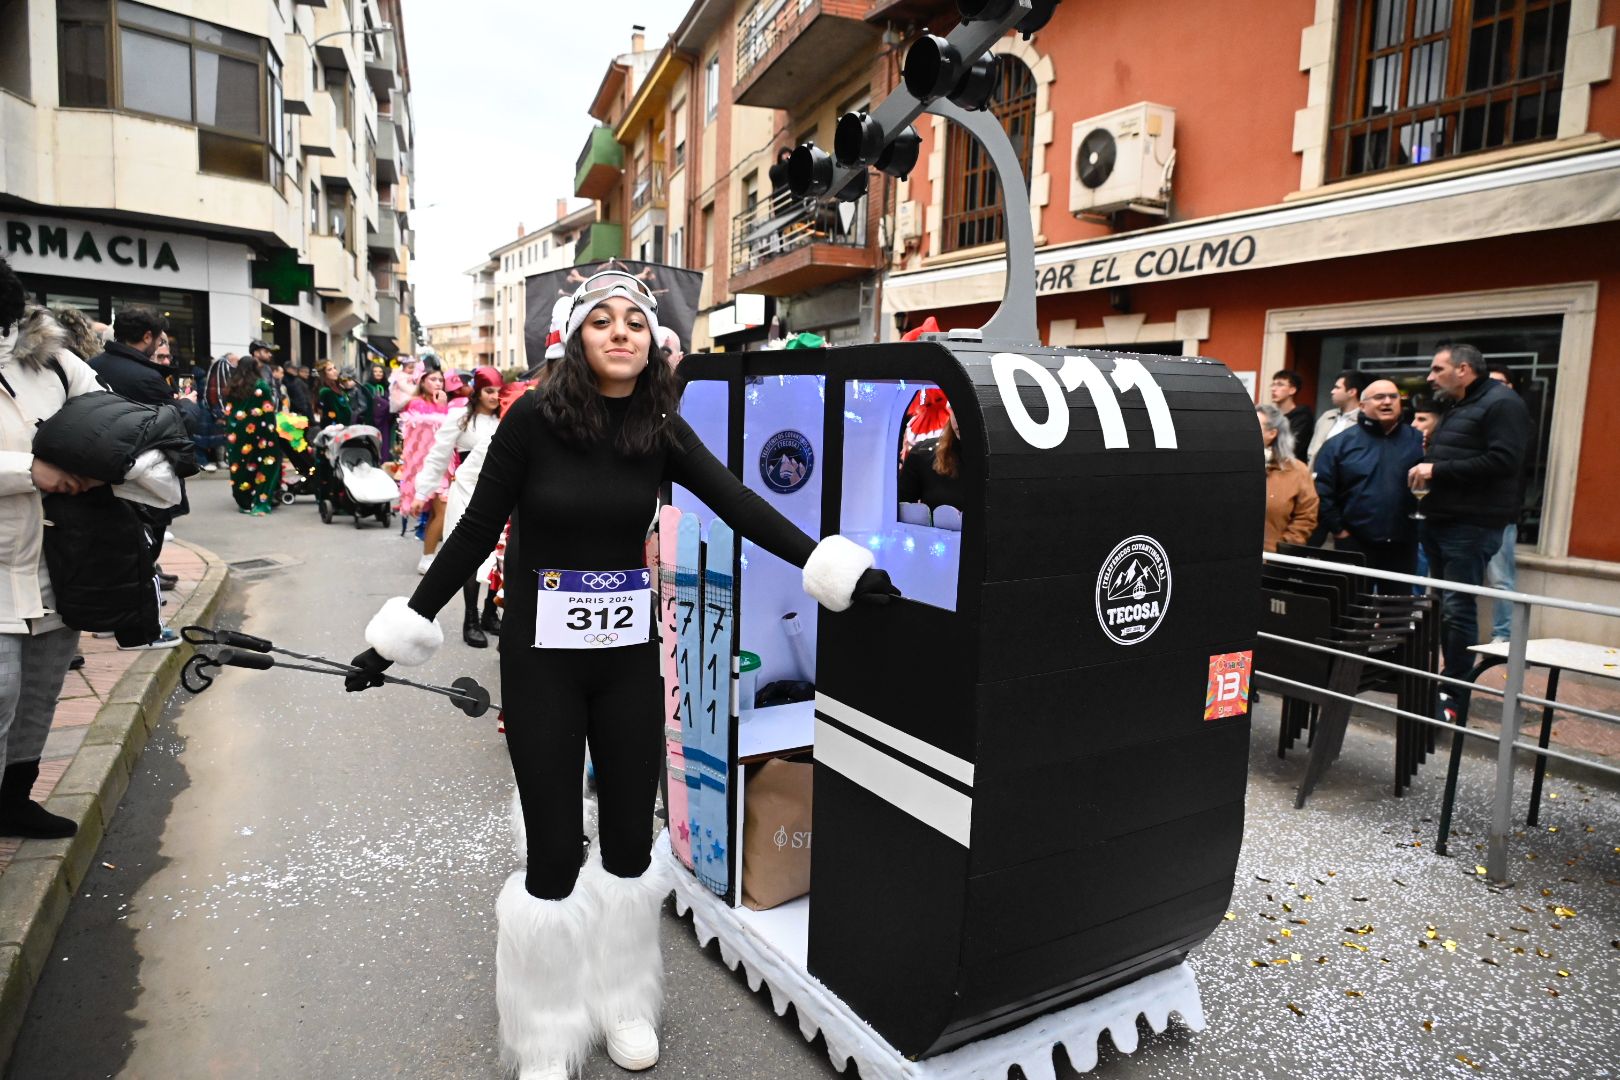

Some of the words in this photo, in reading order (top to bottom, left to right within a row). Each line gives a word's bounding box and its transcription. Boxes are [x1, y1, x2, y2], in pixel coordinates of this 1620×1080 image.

[0, 221, 180, 272] RMACIA
[1089, 256, 1120, 285] EL
[1135, 235, 1256, 278] COLMO
[991, 352, 1178, 450] 011
[568, 596, 604, 604] PARIS
[609, 595, 634, 603] 2024
[1107, 601, 1160, 625] TECOSA
[566, 605, 634, 630] 312
[1216, 671, 1240, 702] 13
